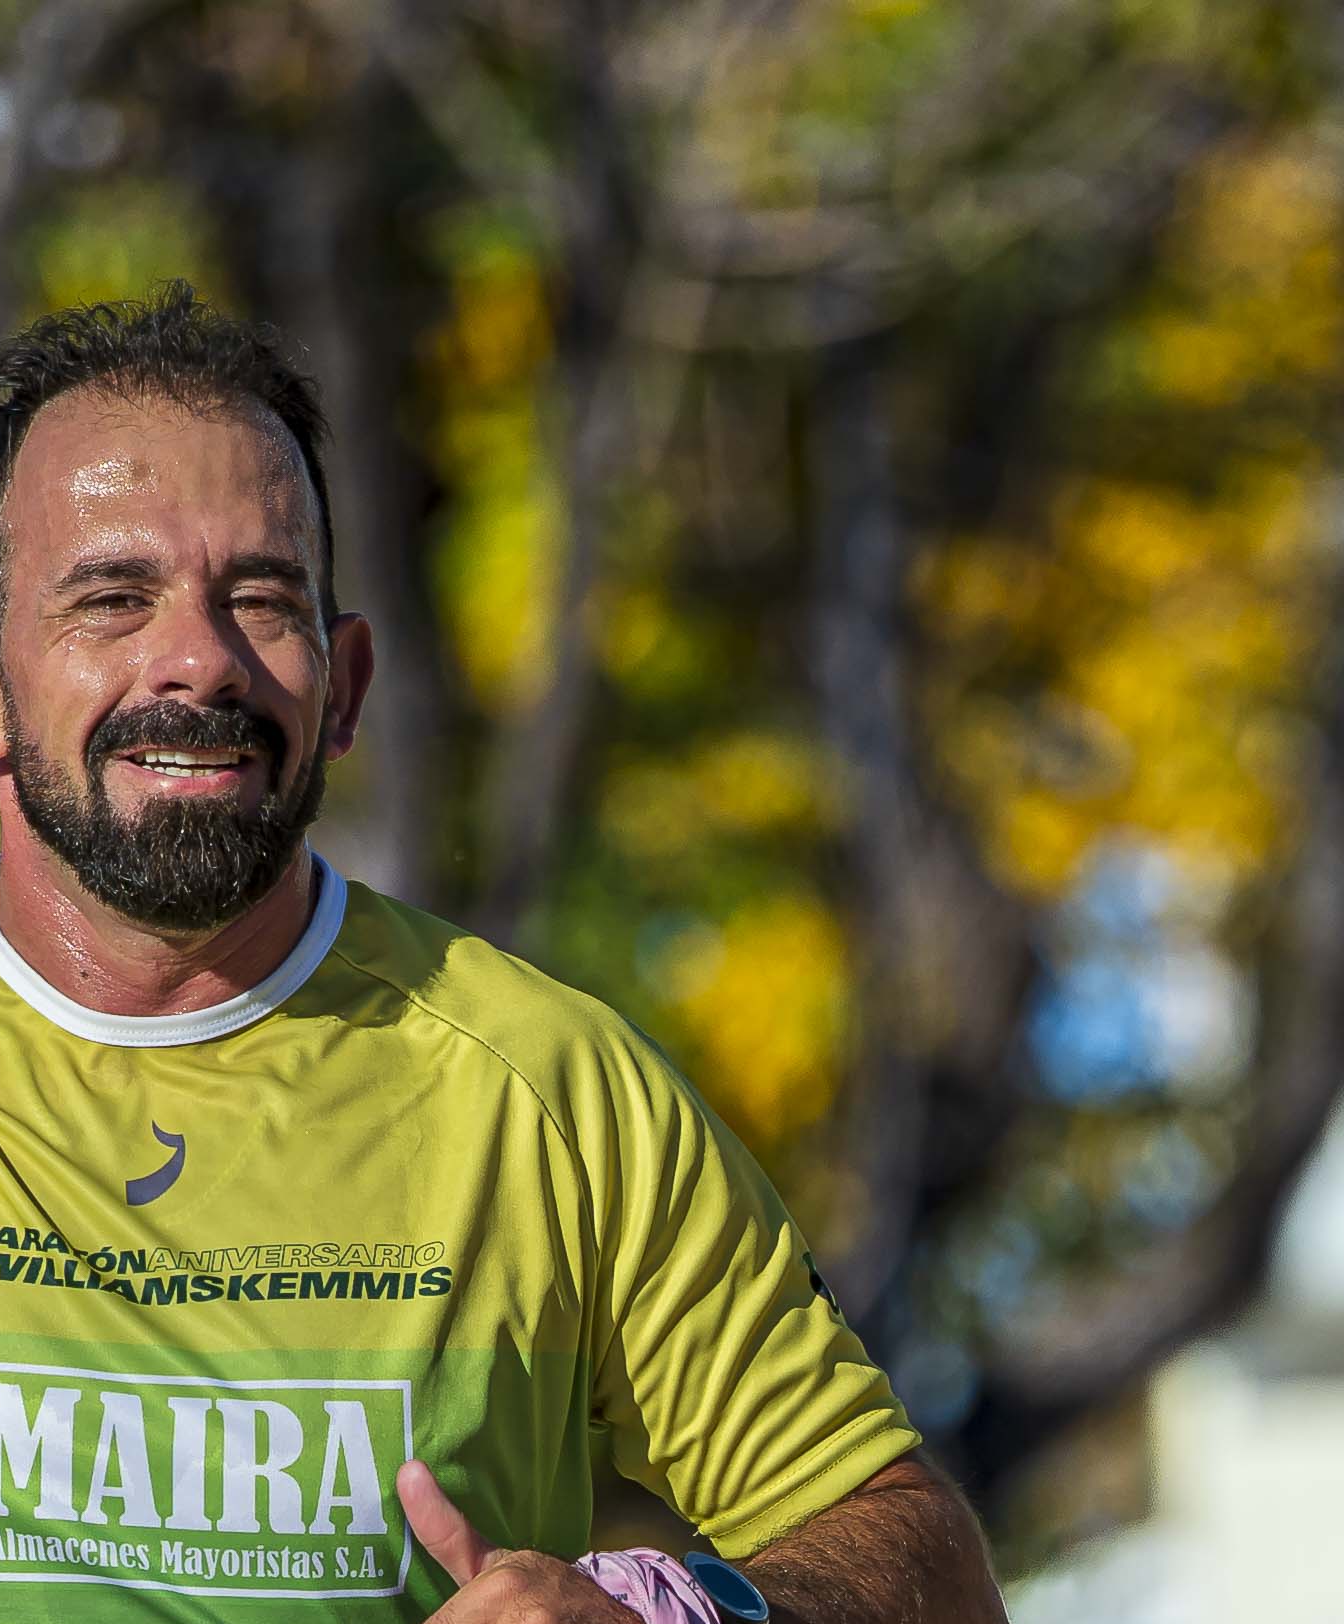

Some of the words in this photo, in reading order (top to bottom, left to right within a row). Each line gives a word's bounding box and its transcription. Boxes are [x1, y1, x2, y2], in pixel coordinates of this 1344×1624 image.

[146, 1240, 445, 1273] ANIVERSARIO
[160, 1540, 325, 1580] Mayoristas
[334, 1545, 385, 1579] S.A.
